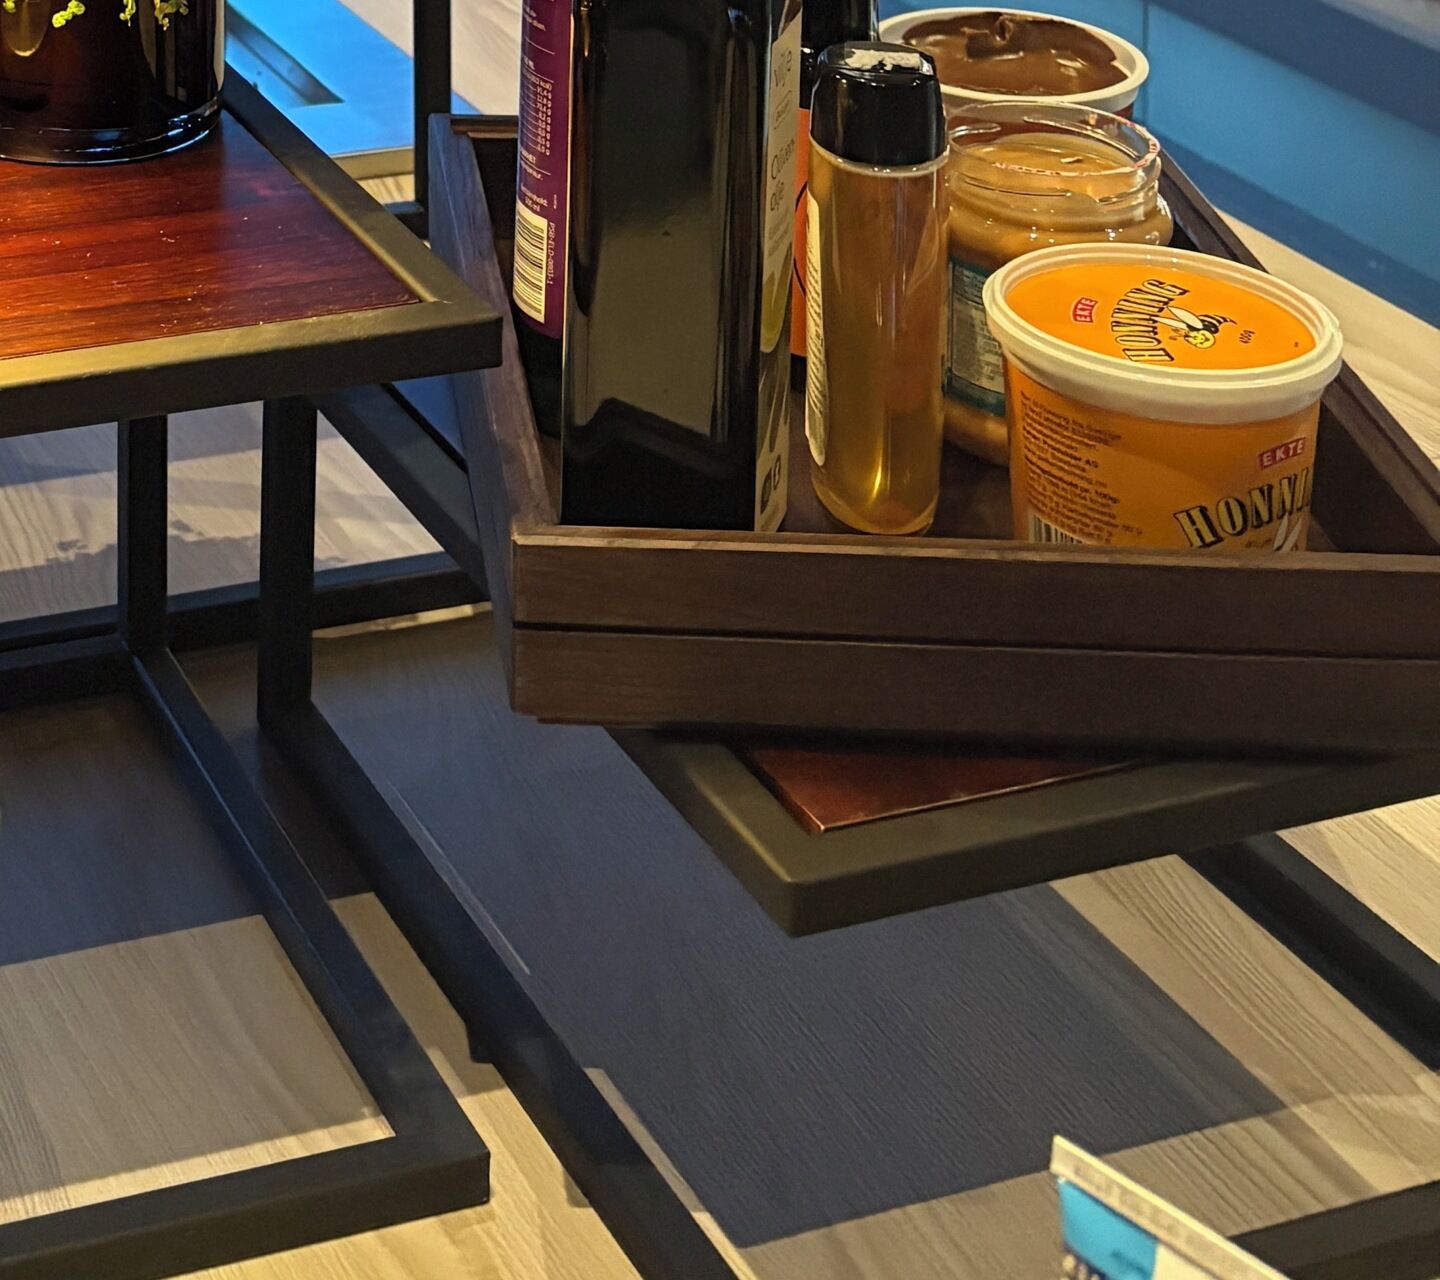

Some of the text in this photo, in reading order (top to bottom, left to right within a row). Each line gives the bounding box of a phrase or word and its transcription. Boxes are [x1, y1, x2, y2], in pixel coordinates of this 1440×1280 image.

[1073, 297, 1097, 324] EKTE
[1110, 278, 1191, 362] HONNING
[1262, 439, 1305, 466] EKTE
[1173, 466, 1313, 550] HONNI
